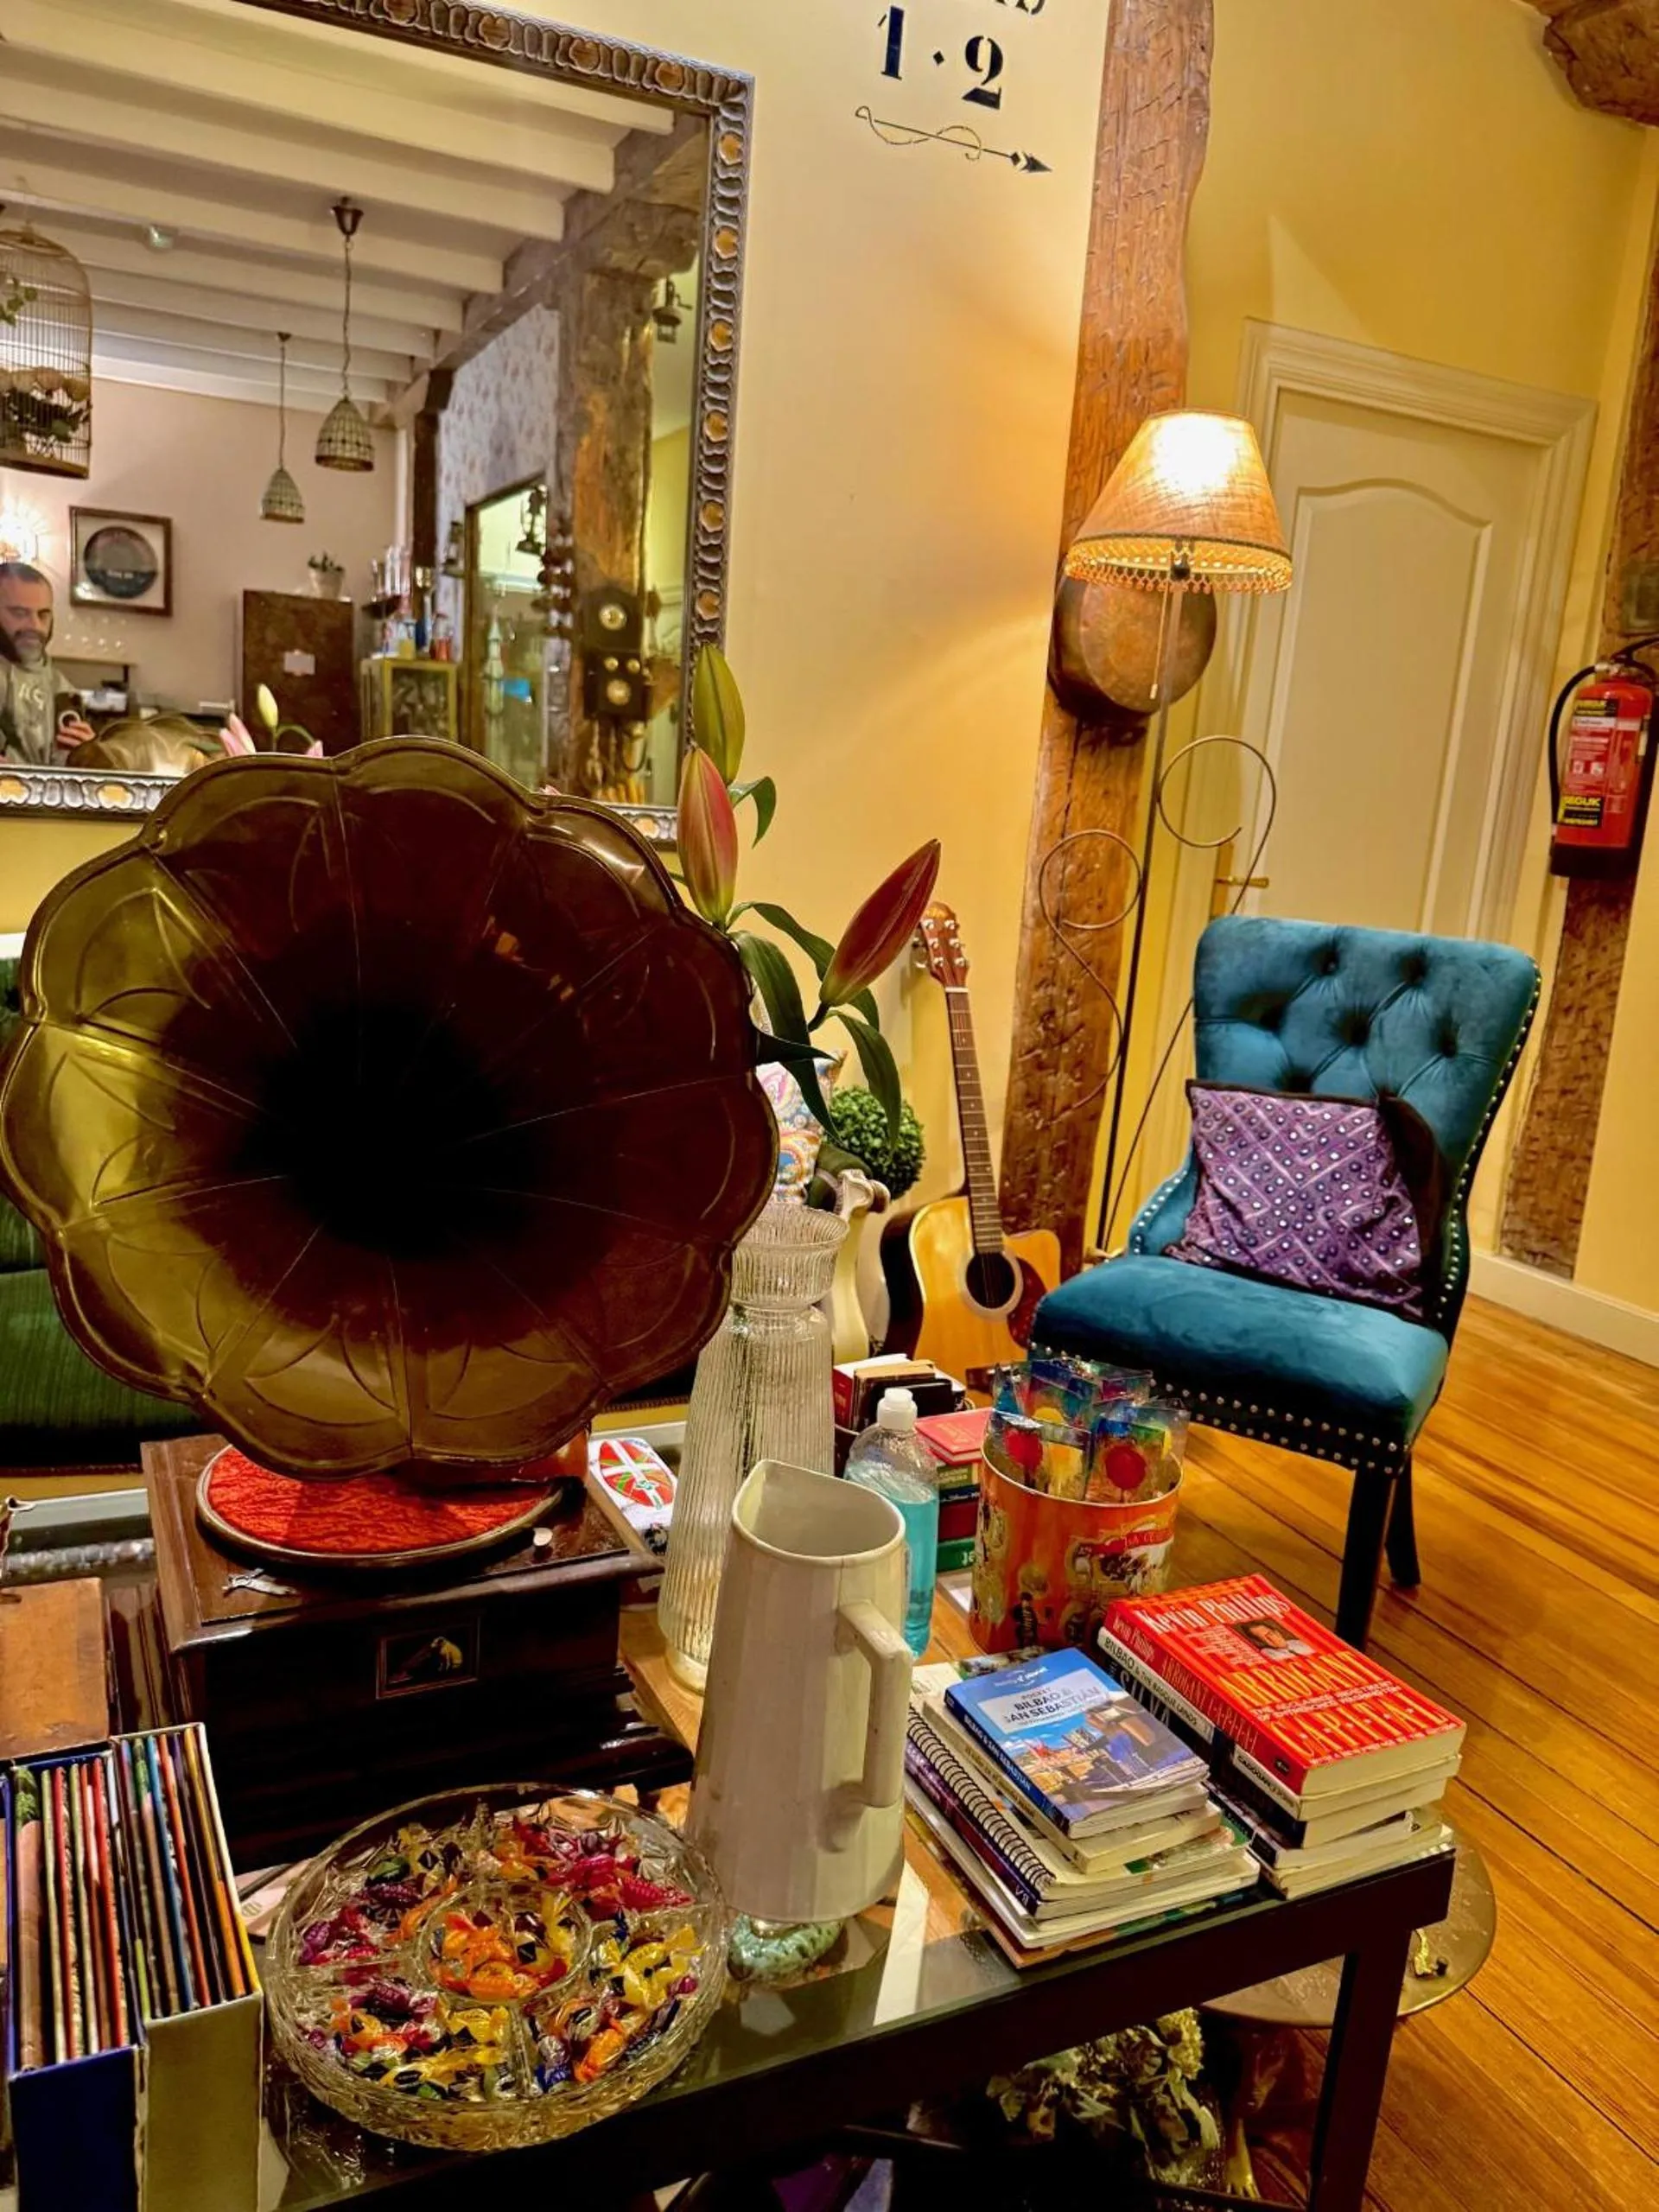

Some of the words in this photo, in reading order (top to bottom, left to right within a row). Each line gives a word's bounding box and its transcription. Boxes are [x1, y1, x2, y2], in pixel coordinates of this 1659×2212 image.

[1133, 1604, 1211, 1636] Kevin
[1196, 1591, 1290, 1626] Phillips
[1104, 1636, 1135, 1669] BILBAO
[1217, 1650, 1383, 1711] ARROGANT
[1014, 1689, 1062, 1712] BILBAO
